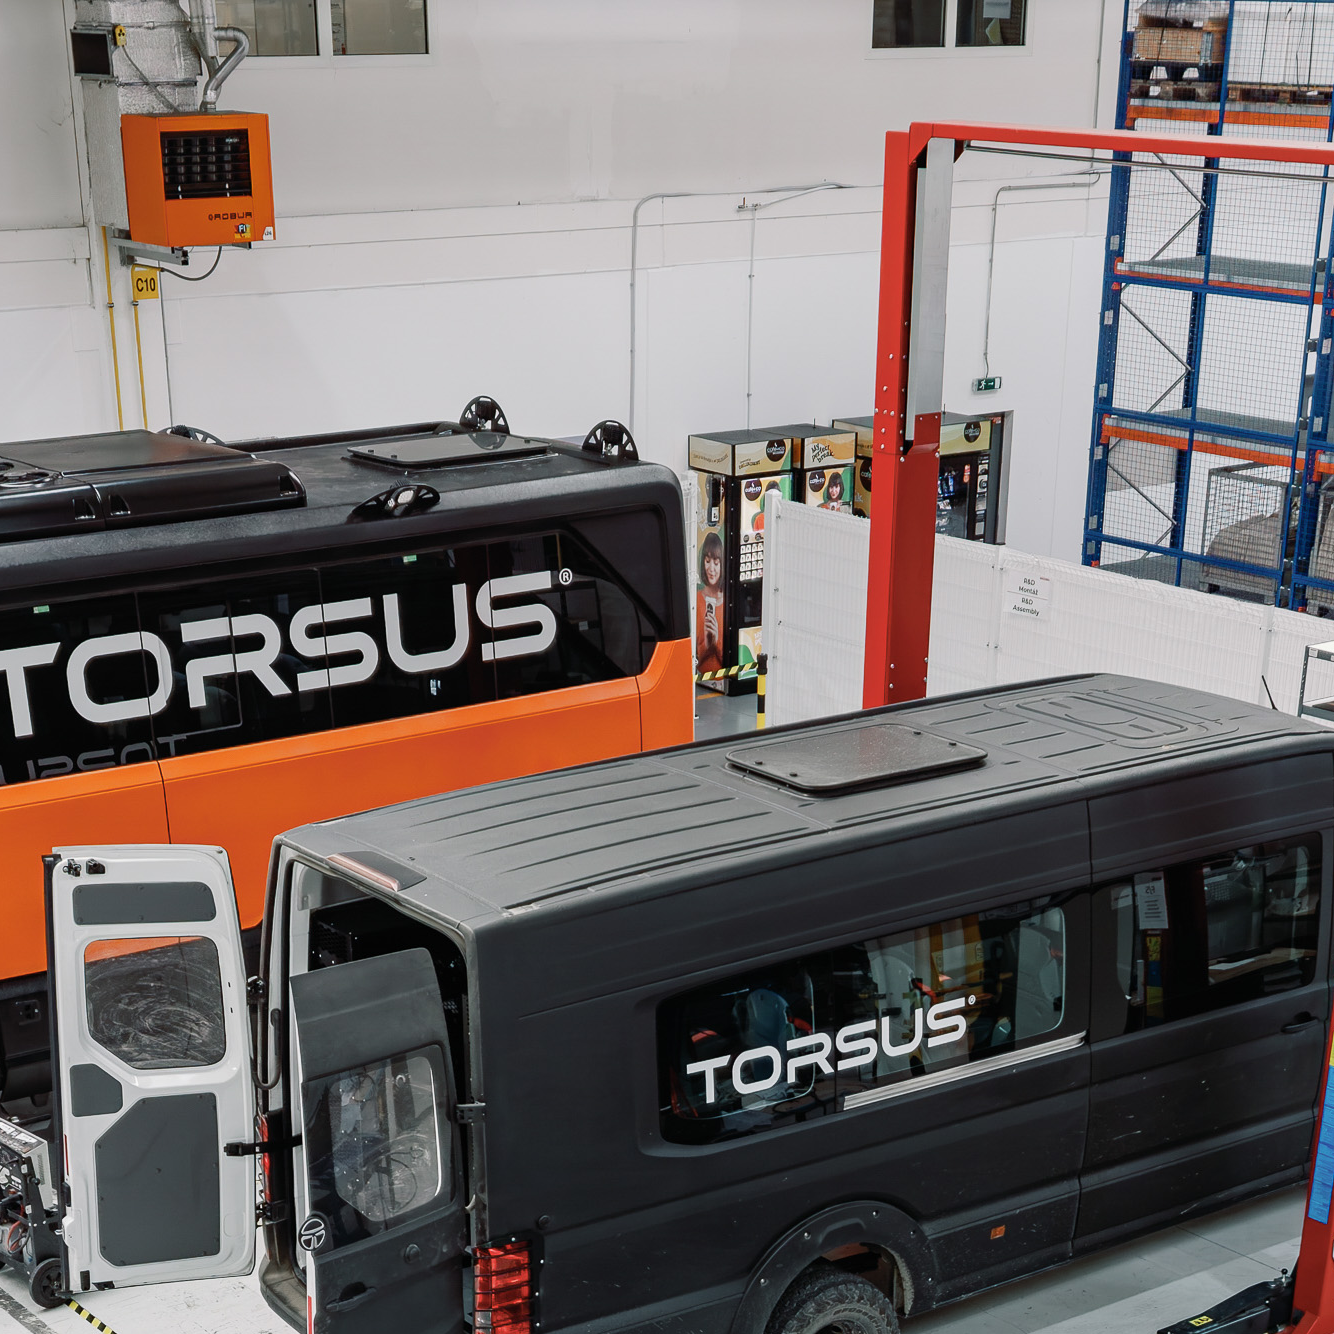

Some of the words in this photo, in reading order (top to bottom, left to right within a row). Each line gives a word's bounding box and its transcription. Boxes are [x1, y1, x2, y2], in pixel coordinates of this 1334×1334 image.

[136, 277, 156, 292] C10
[1023, 578, 1036, 586] R&D
[1021, 597, 1034, 605] R&D
[1013, 604, 1040, 617] Assembly
